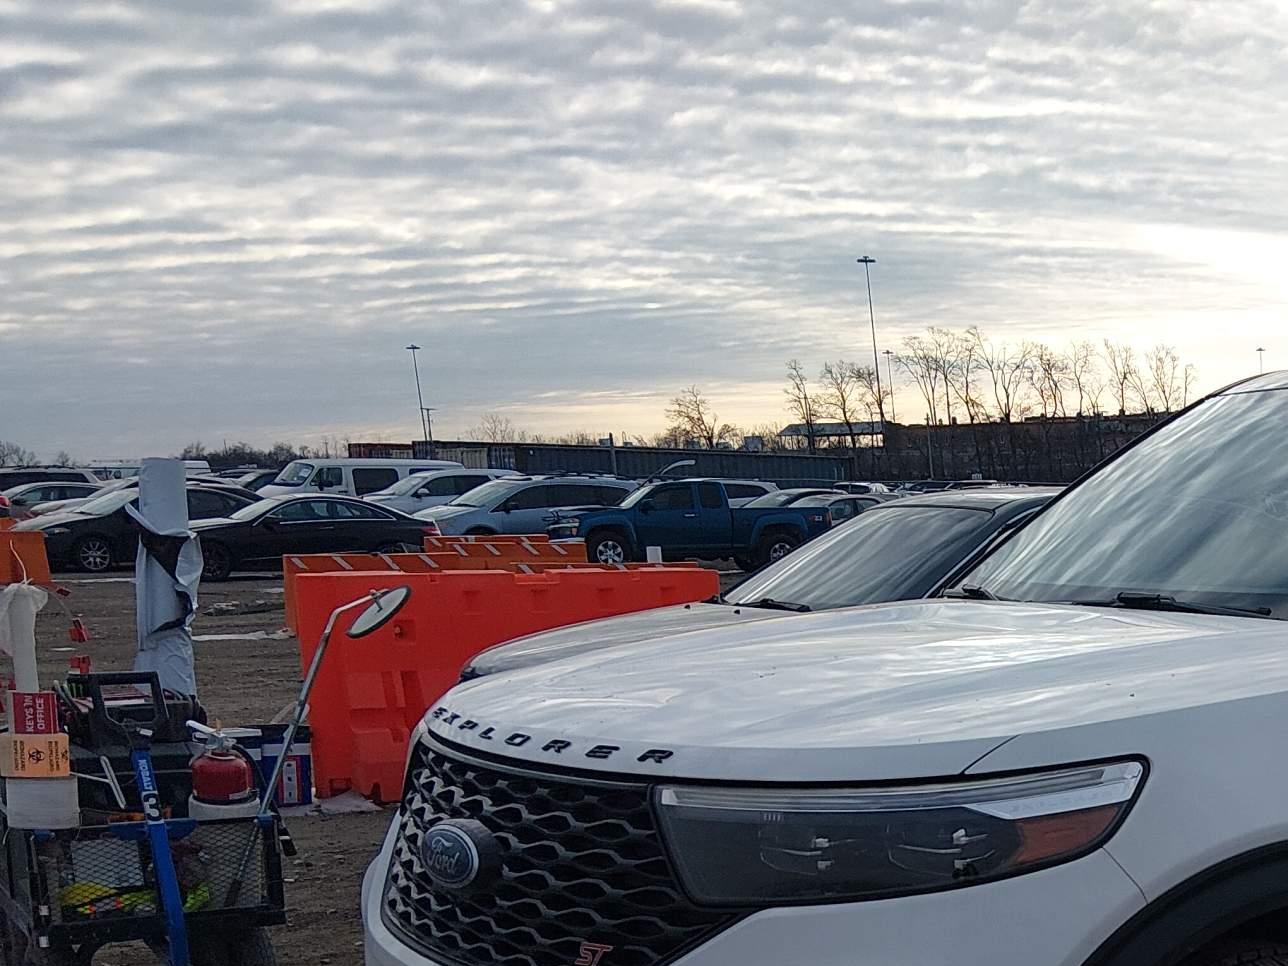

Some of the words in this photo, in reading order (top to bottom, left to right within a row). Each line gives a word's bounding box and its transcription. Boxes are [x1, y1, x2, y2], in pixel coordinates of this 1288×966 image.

[24, 695, 33, 706] IN
[36, 698, 45, 730] OFFICE
[25, 708, 34, 732] KEYS
[432, 706, 675, 764] EXPLORER
[138, 759, 153, 791] KOBALT
[426, 836, 460, 874] Ford
[574, 942, 614, 966] ST
